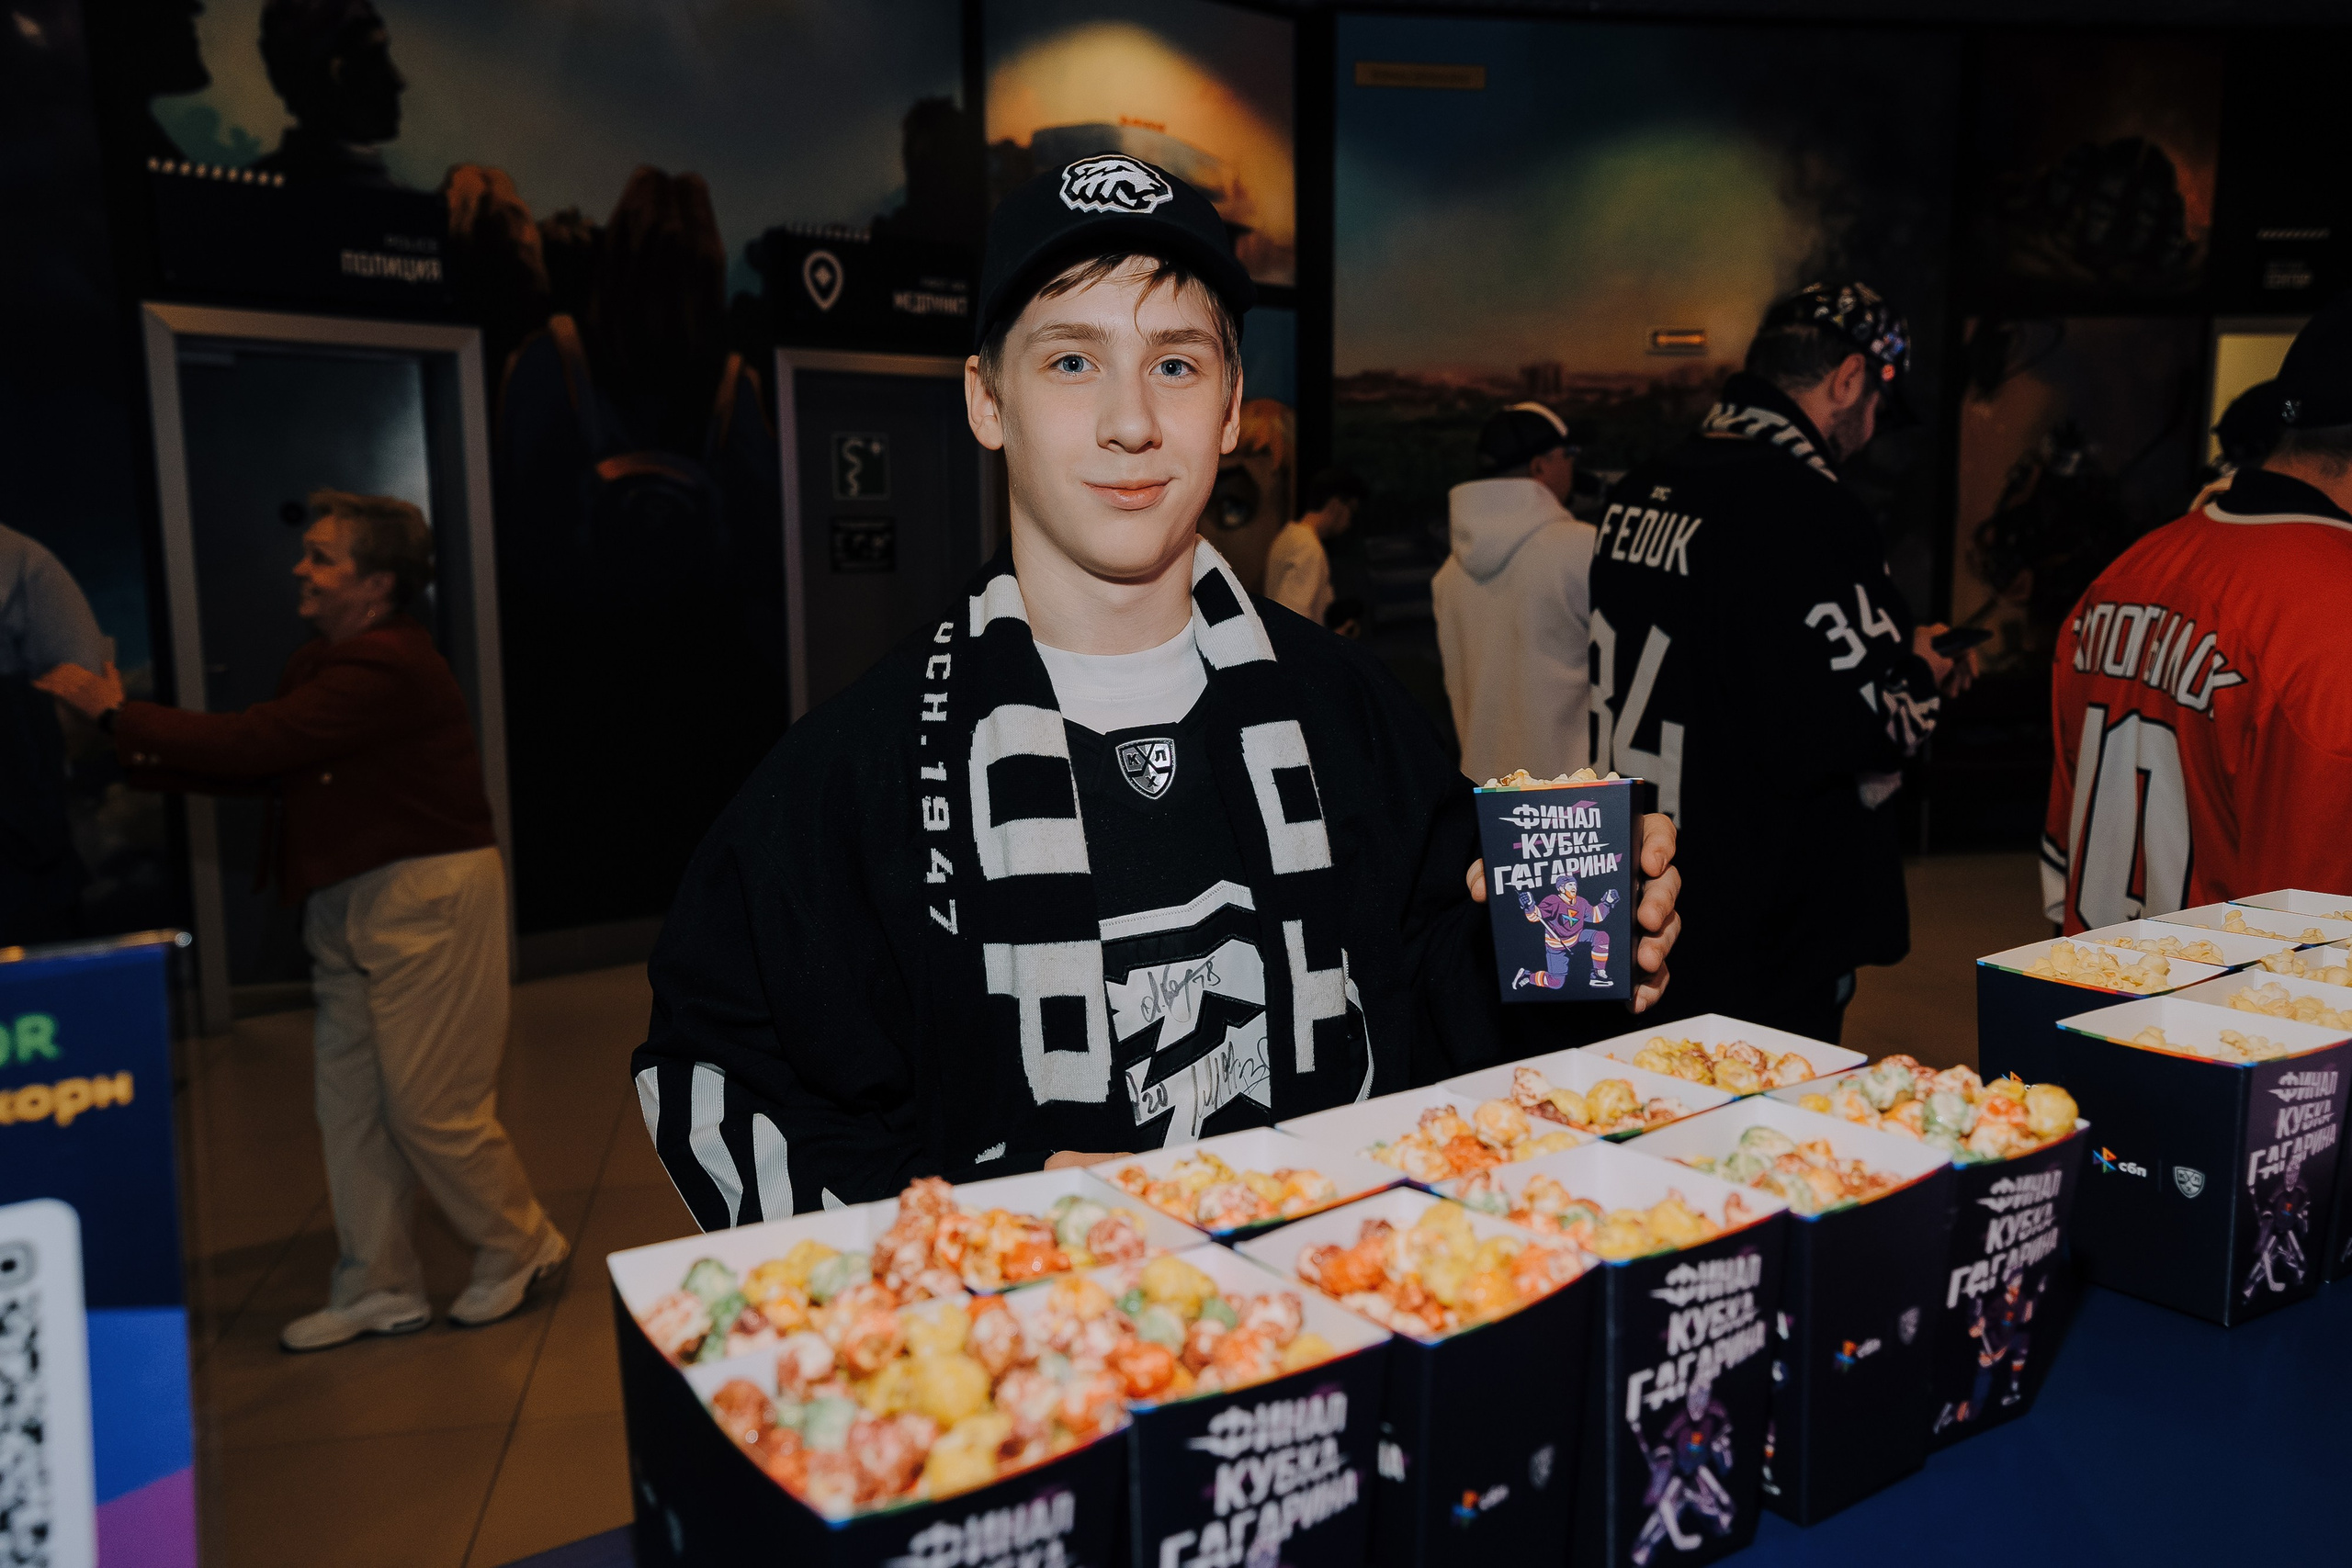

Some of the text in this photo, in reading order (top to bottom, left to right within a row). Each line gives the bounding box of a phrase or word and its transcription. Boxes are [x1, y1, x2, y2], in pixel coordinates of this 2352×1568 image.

[340, 249, 444, 284] ПОЛИЦИЯ
[1595, 502, 1703, 576] FEDUK
[1803, 582, 1903, 671] 34
[1499, 804, 1601, 829] ФИНАЛ
[1521, 831, 1609, 860] КУБКА
[1494, 854, 1618, 895] ГАГАРИНА
[2268, 1070, 2339, 1102] ФИНАЛ
[2275, 1100, 2335, 1139] КУБКА
[2118, 1161, 2148, 1179] сбп
[2246, 1122, 2337, 1186] ГАГАРИНА
[1974, 1169, 2064, 1213] ФИНАЛ
[1984, 1202, 2060, 1255] КУБКА
[1649, 1253, 1763, 1306] ФИНАЛ
[1945, 1226, 2060, 1310] ГАГАРИНА
[1666, 1292, 1762, 1356] КУБКА
[1624, 1320, 1767, 1424] ГАГАРИНА
[1185, 1391, 1349, 1459] ФИНАЛ
[1213, 1436, 1351, 1517] КУБКА
[884, 1490, 1076, 1568] ФИНАЛ
